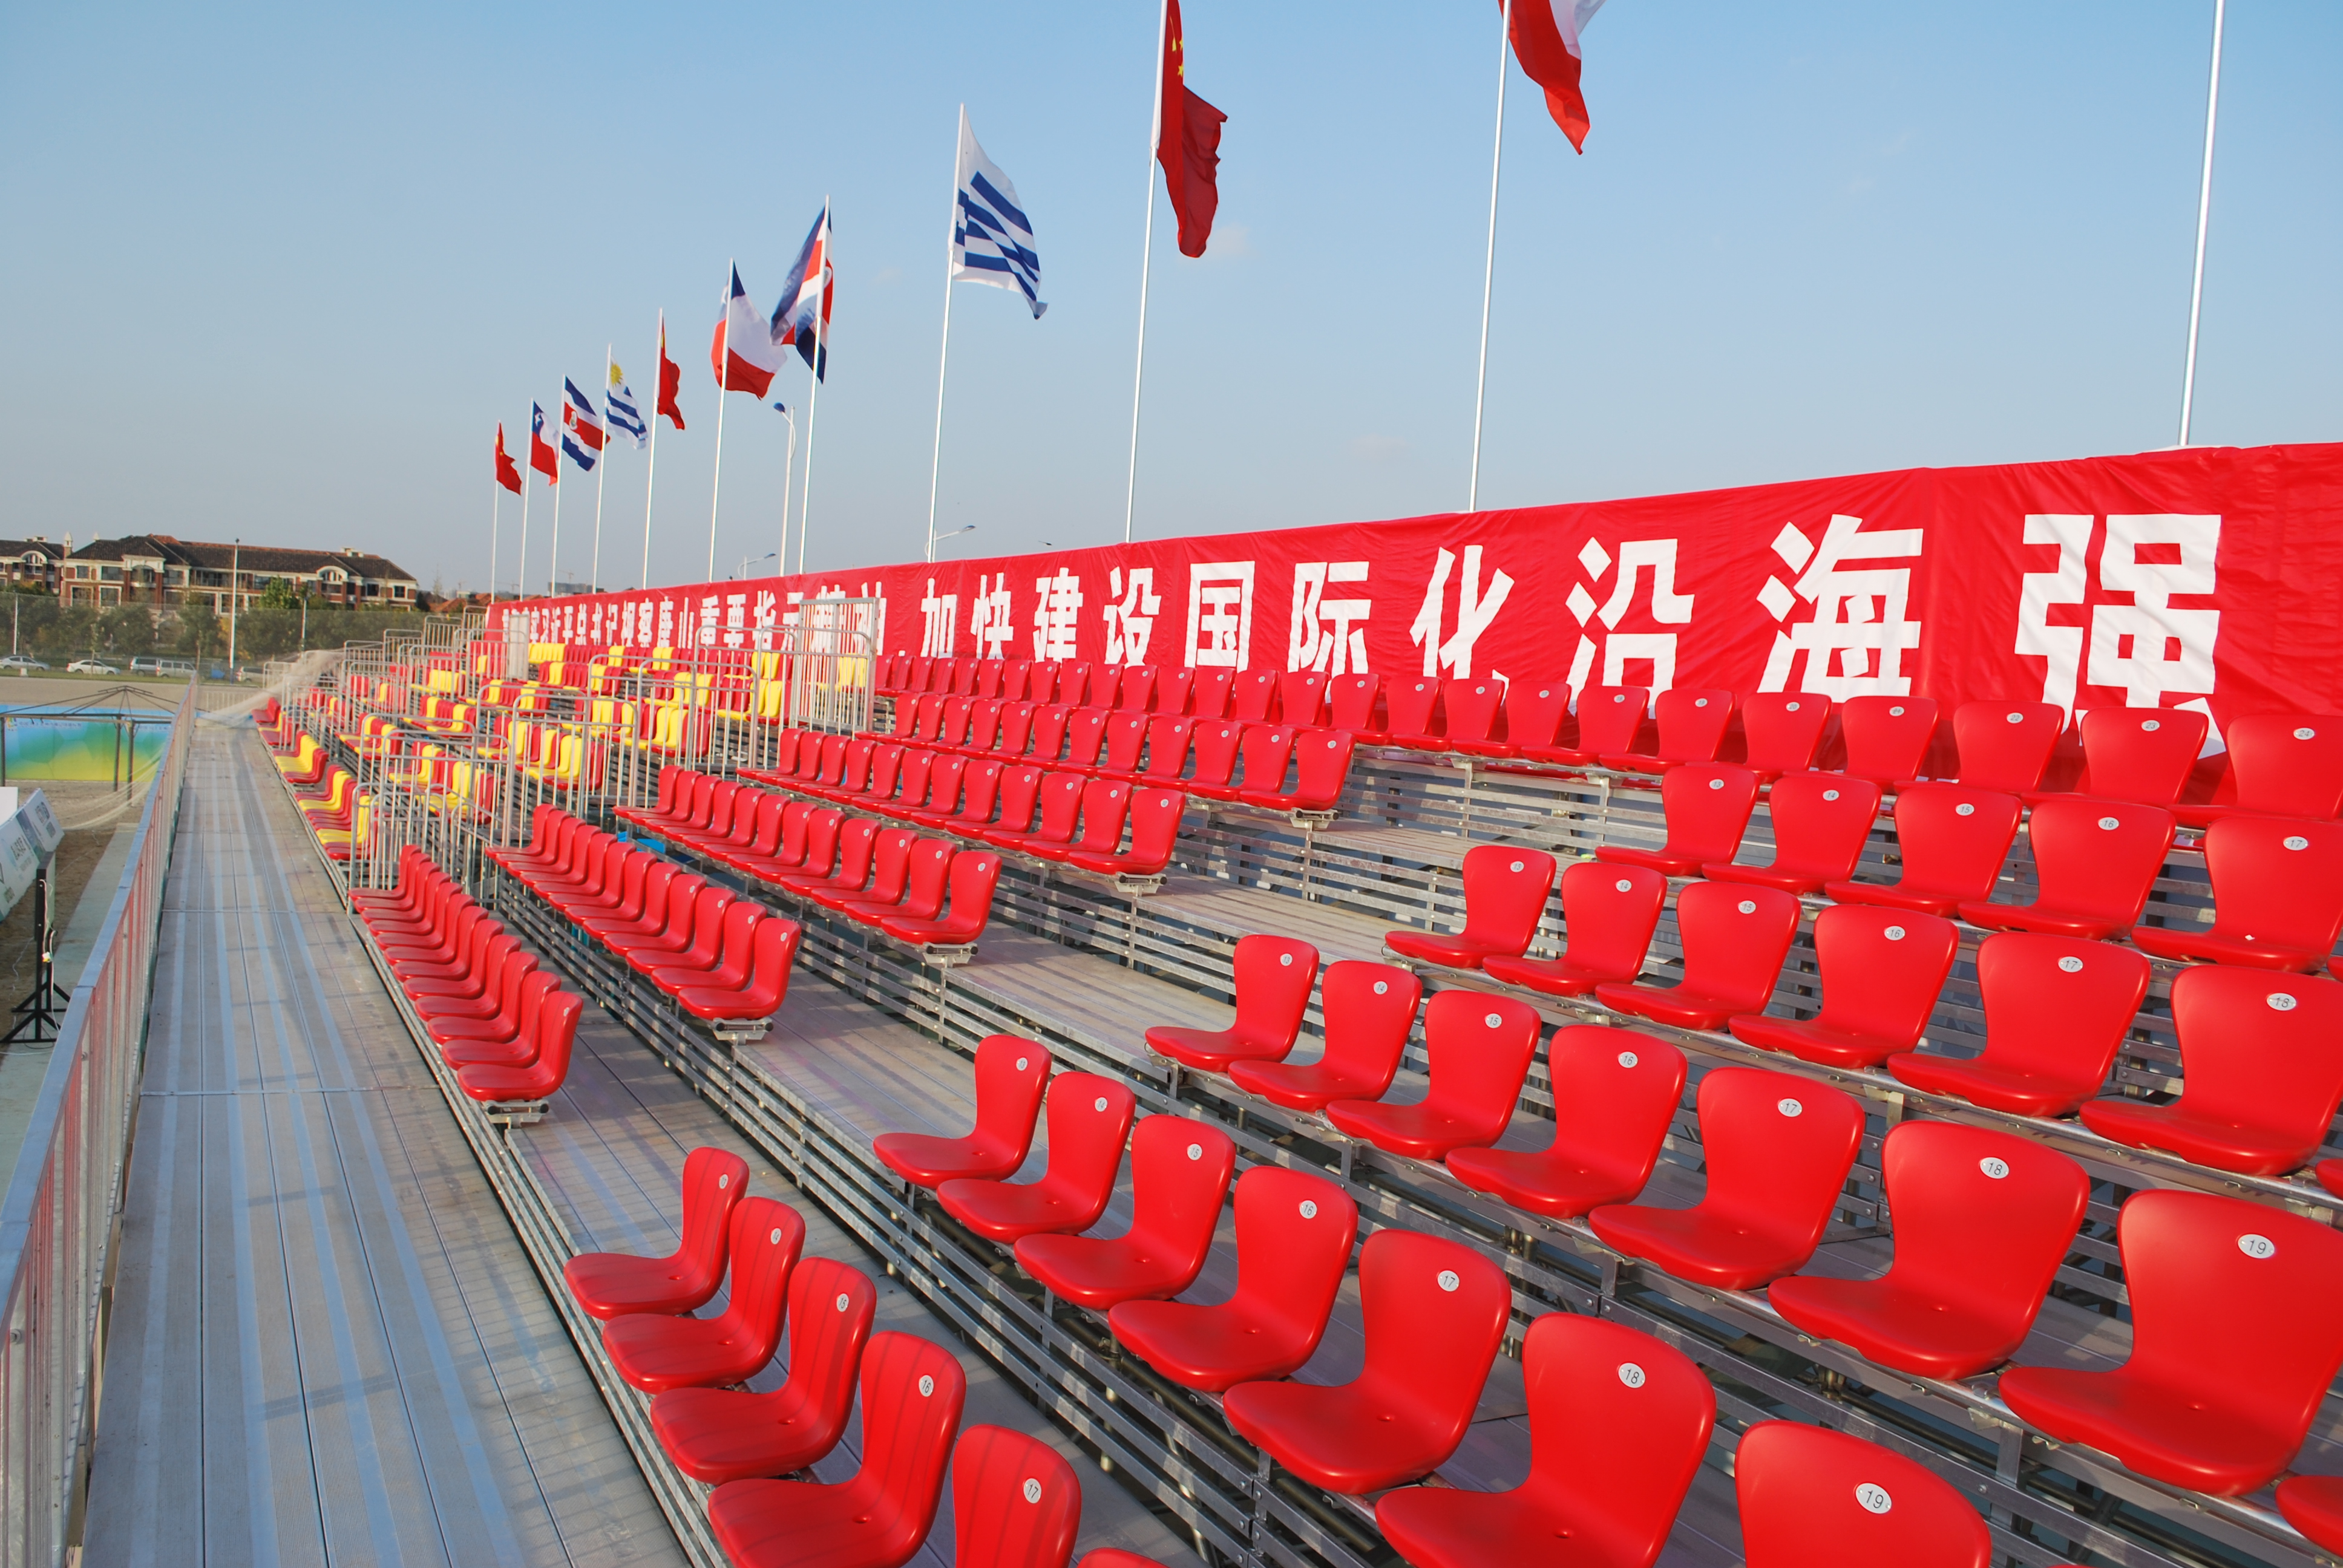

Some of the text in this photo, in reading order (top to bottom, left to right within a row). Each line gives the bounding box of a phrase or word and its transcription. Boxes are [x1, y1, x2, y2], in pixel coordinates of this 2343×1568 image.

[2104, 820, 2114, 828] 16
[1743, 903, 1752, 912] 15
[1890, 929, 1901, 938] 16
[2065, 960, 2078, 969] 17
[2276, 997, 2290, 1008] 18
[1490, 1016, 1499, 1026] 15
[1624, 1055, 1634, 1065] 16
[1785, 1103, 1798, 1113] 17
[1988, 1162, 2003, 1175] 18
[1303, 1204, 1314, 1216] 16
[2249, 1240, 2267, 1255] 19
[1444, 1275, 1456, 1287] 17
[1626, 1368, 1640, 1384] 18
[922, 1380, 931, 1393] 16
[1027, 1483, 1039, 1498] 17
[1866, 1490, 1884, 1509] 19
